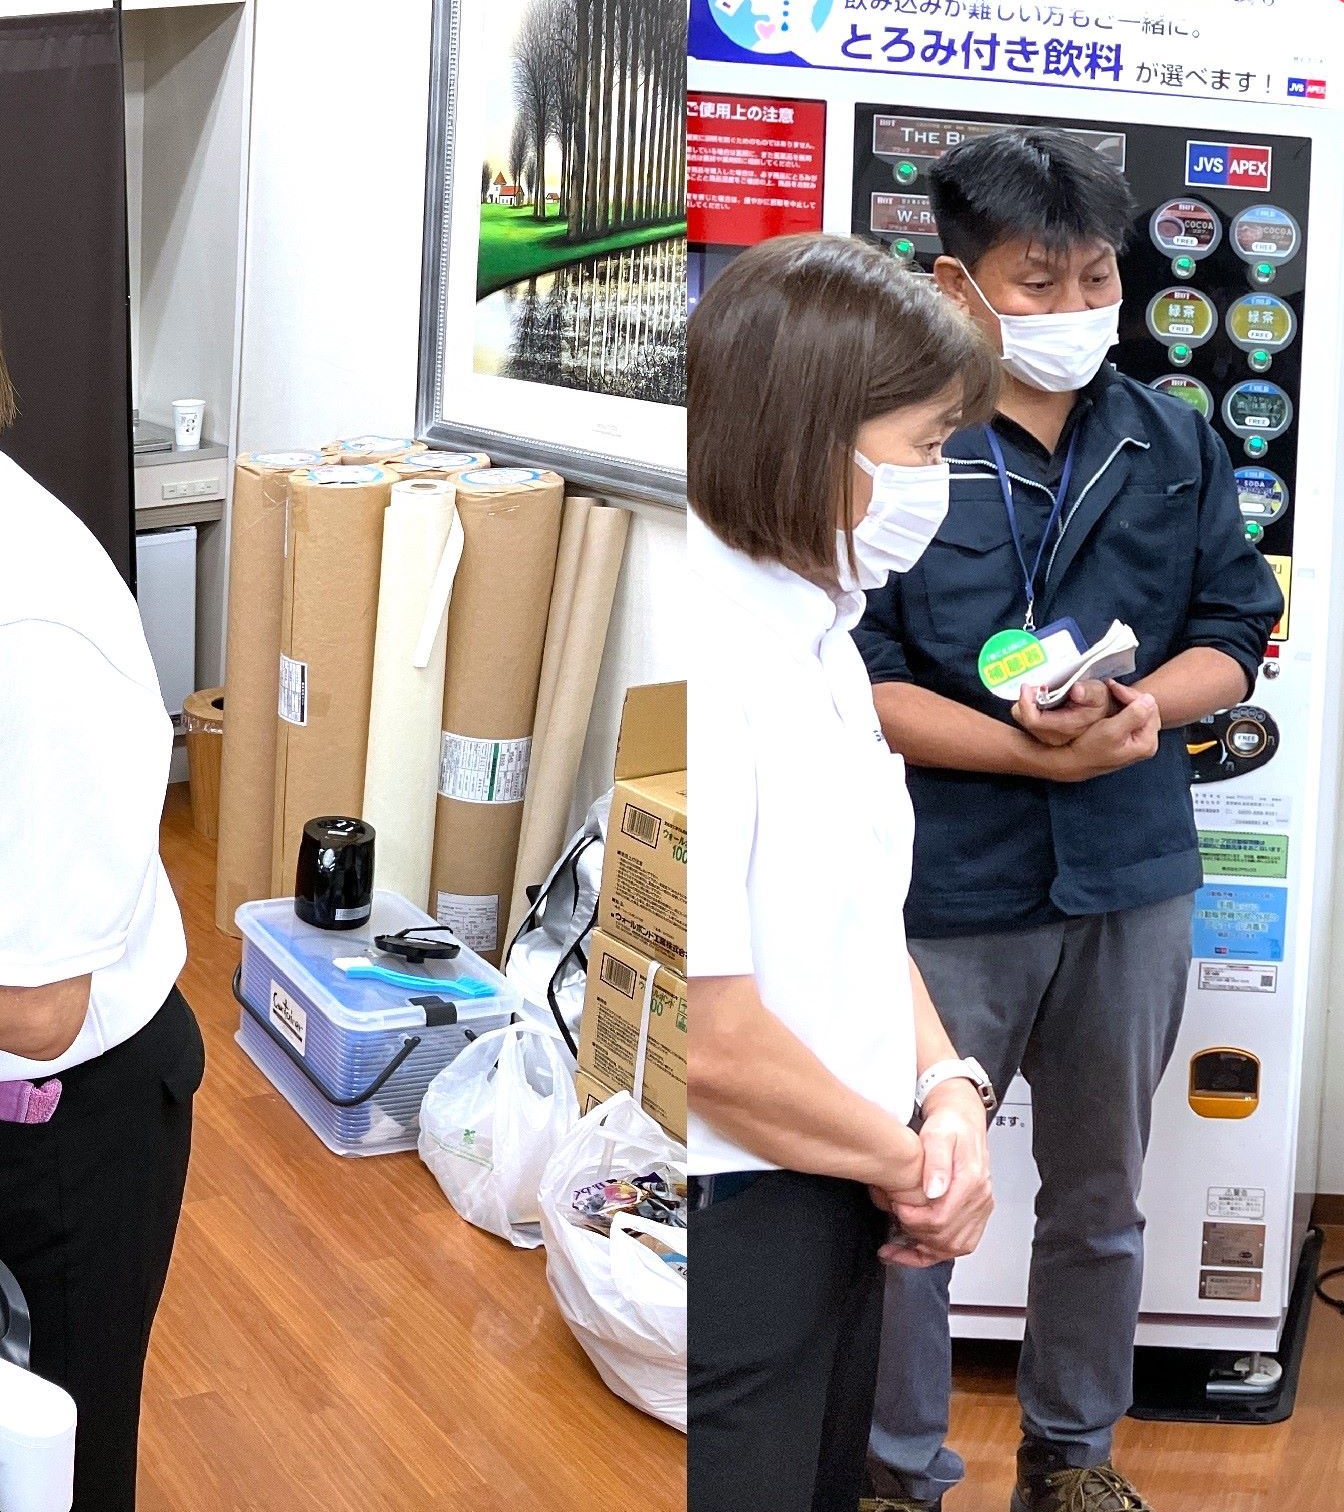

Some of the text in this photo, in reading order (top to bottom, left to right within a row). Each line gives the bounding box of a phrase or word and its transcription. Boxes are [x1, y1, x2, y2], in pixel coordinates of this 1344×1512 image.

[840, 23, 1272, 94] とろみ付き飲料 が選べます！
[900, 126, 940, 145] THE
[1193, 156, 1268, 177] JVS APEX
[1184, 219, 1214, 230] COCOA
